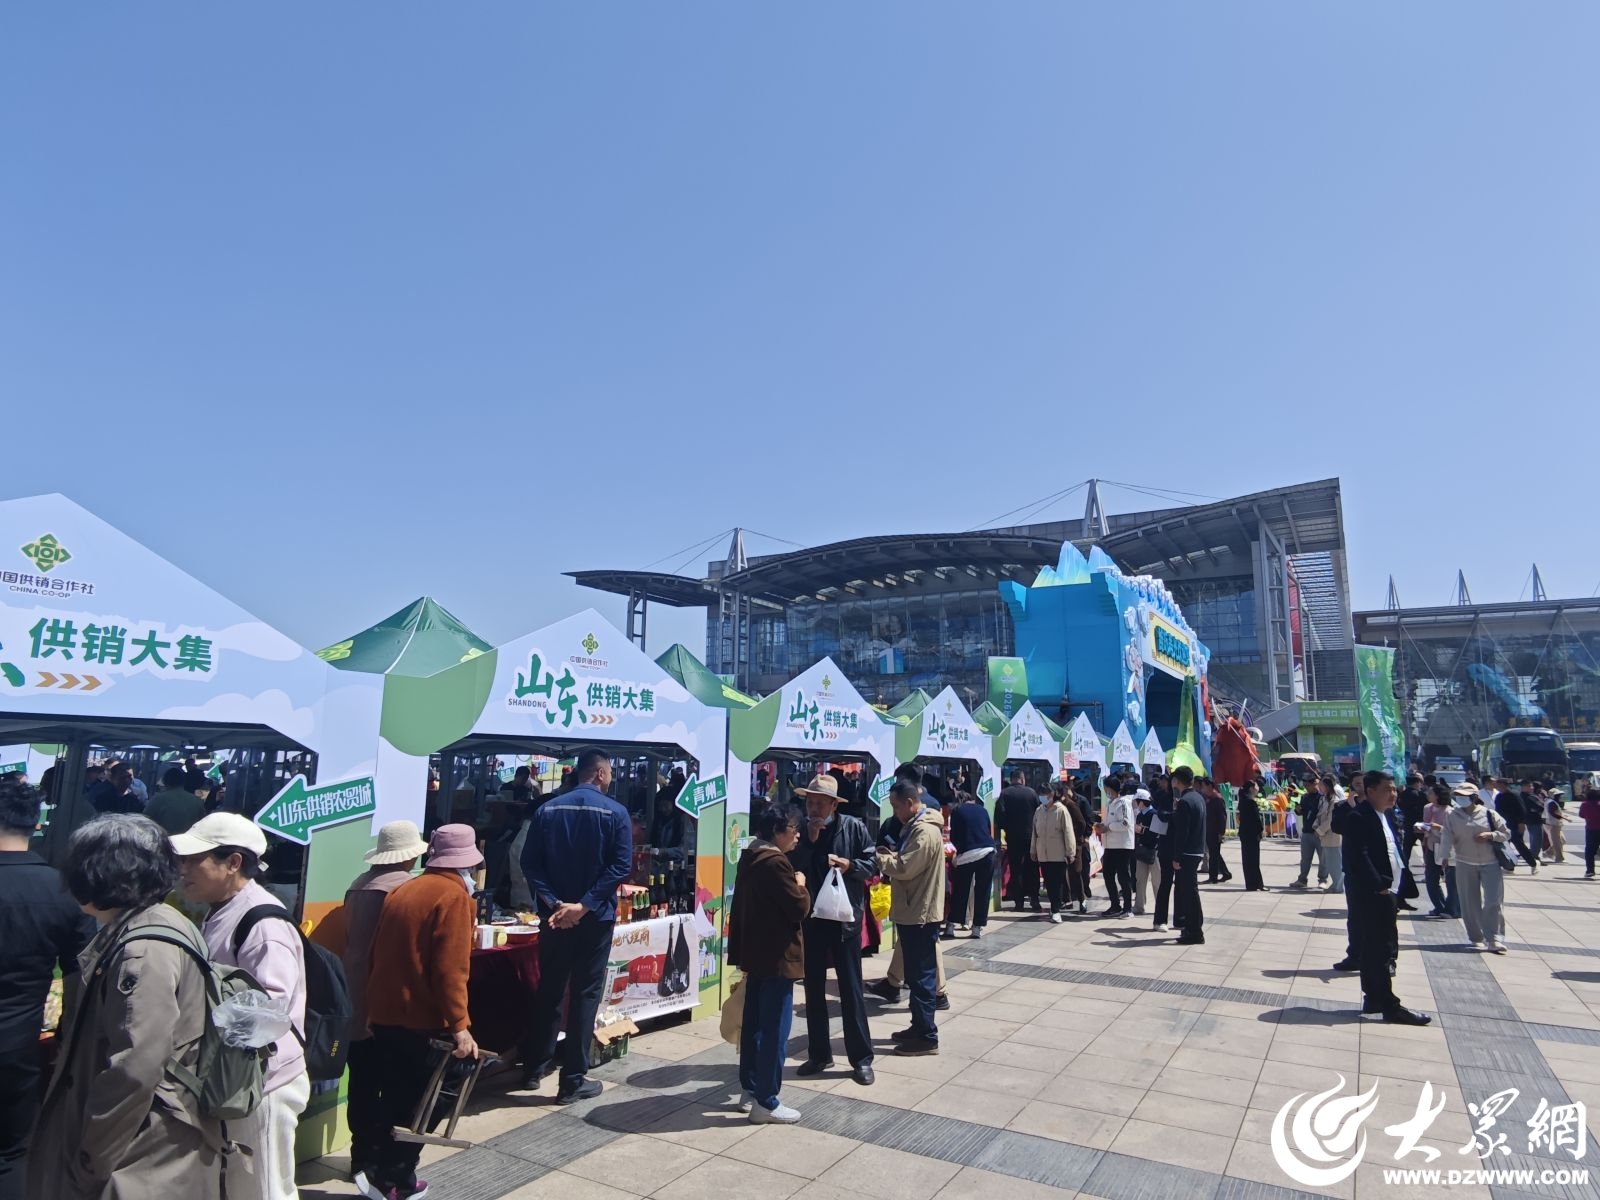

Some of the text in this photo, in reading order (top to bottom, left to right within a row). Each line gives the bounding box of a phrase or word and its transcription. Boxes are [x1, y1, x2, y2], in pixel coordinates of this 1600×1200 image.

[0, 571, 95, 594] 国供销合作社
[9, 585, 71, 598] CHINA CO-OP
[28, 617, 213, 673] 供销大集
[508, 698, 547, 709] SHANDONG
[514, 653, 587, 728] 山东
[586, 682, 654, 711] 供销大集
[789, 690, 824, 742] 山东
[824, 709, 857, 729] 供销大集
[277, 782, 373, 827] 山东供销农贸城
[692, 780, 717, 806] 青州
